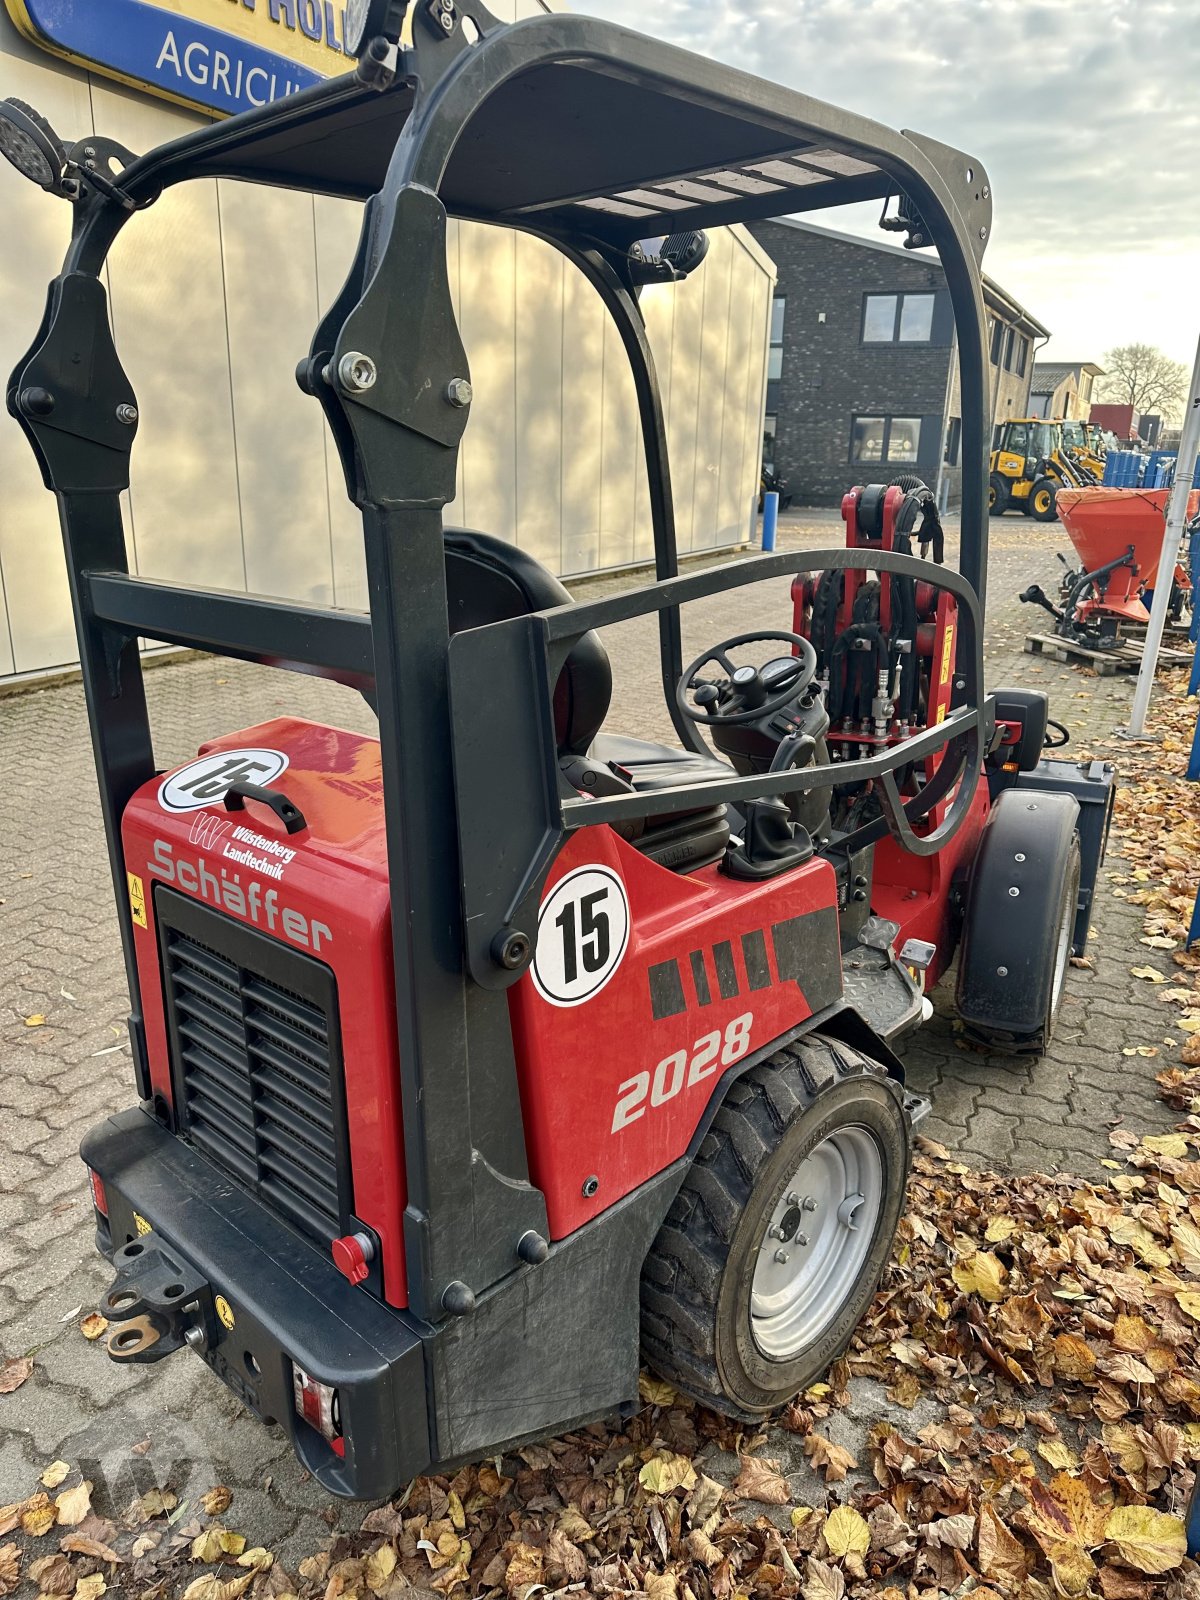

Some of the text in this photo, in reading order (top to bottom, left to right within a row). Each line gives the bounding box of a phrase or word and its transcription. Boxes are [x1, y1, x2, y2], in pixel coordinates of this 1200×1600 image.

[177, 757, 272, 799] 15
[222, 842, 285, 881] Landtechnik
[231, 825, 297, 864] Wüstenberg
[147, 838, 333, 952] Schäffer
[555, 886, 611, 985] 15
[610, 1011, 754, 1136] 2028
